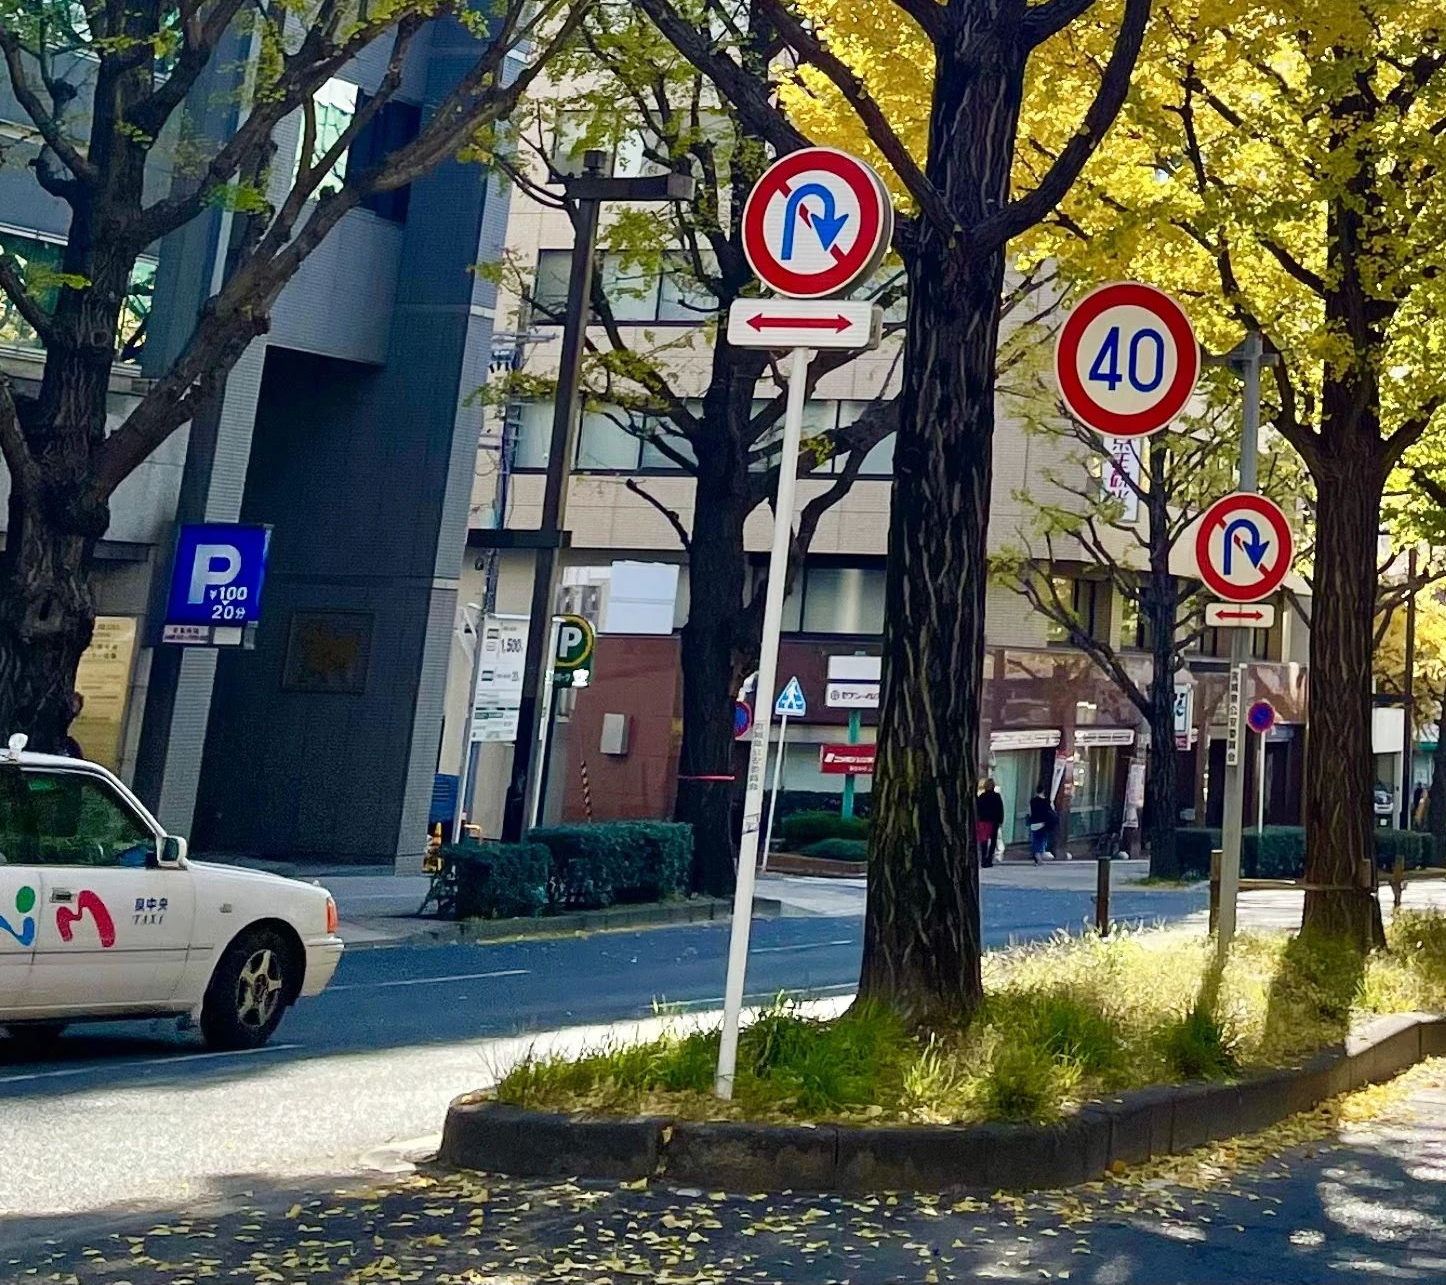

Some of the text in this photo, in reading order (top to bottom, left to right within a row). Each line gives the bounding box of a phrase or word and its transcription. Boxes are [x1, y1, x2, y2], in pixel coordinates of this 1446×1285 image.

[1089, 327, 1164, 392] 40
[187, 544, 241, 604] P
[212, 605, 246, 619] 20分
[559, 626, 582, 658] P
[132, 914, 165, 926] TAXI
